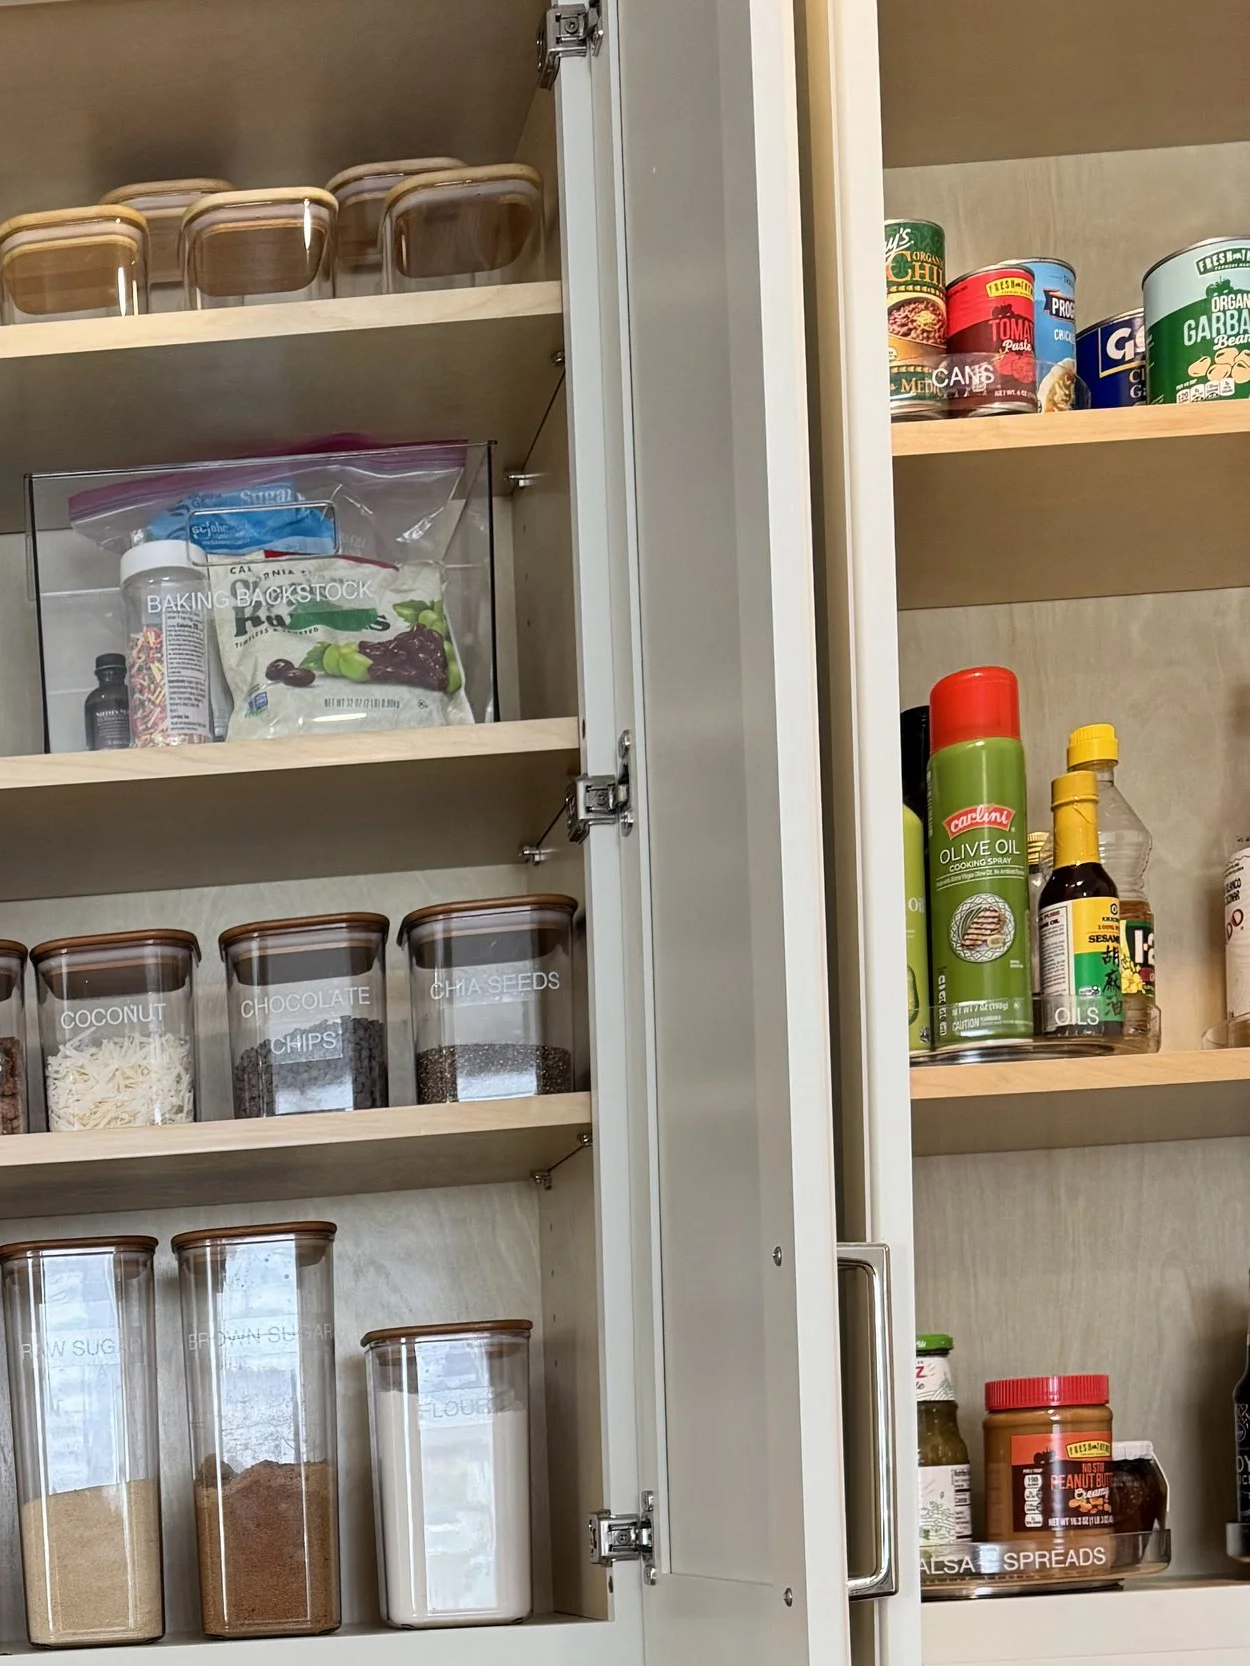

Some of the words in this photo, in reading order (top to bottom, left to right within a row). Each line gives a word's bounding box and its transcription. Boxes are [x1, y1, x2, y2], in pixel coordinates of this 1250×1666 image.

[1002, 338, 1033, 354] Paste
[932, 362, 995, 388] CANS
[147, 589, 229, 614] BAKING
[237, 579, 373, 609] BACKSTOCK
[950, 803, 1009, 832] carlini
[939, 839, 991, 864] OLIVE
[995, 838, 1020, 854] OIL
[949, 857, 986, 872] COOKING
[987, 857, 1012, 867] SPRAY
[488, 970, 561, 993] SEEDS
[240, 986, 371, 1019] CHOCOLATE
[59, 1004, 167, 1030] COCONUT
[952, 1018, 980, 1032] CAUTION
[1054, 1007, 1100, 1025] OILS
[269, 1030, 338, 1056] CHIPS
[1050, 1472, 1095, 1490] PEANUT
[1074, 1487, 1109, 1500] Creamy
[1003, 1547, 1107, 1571] SPREADS
